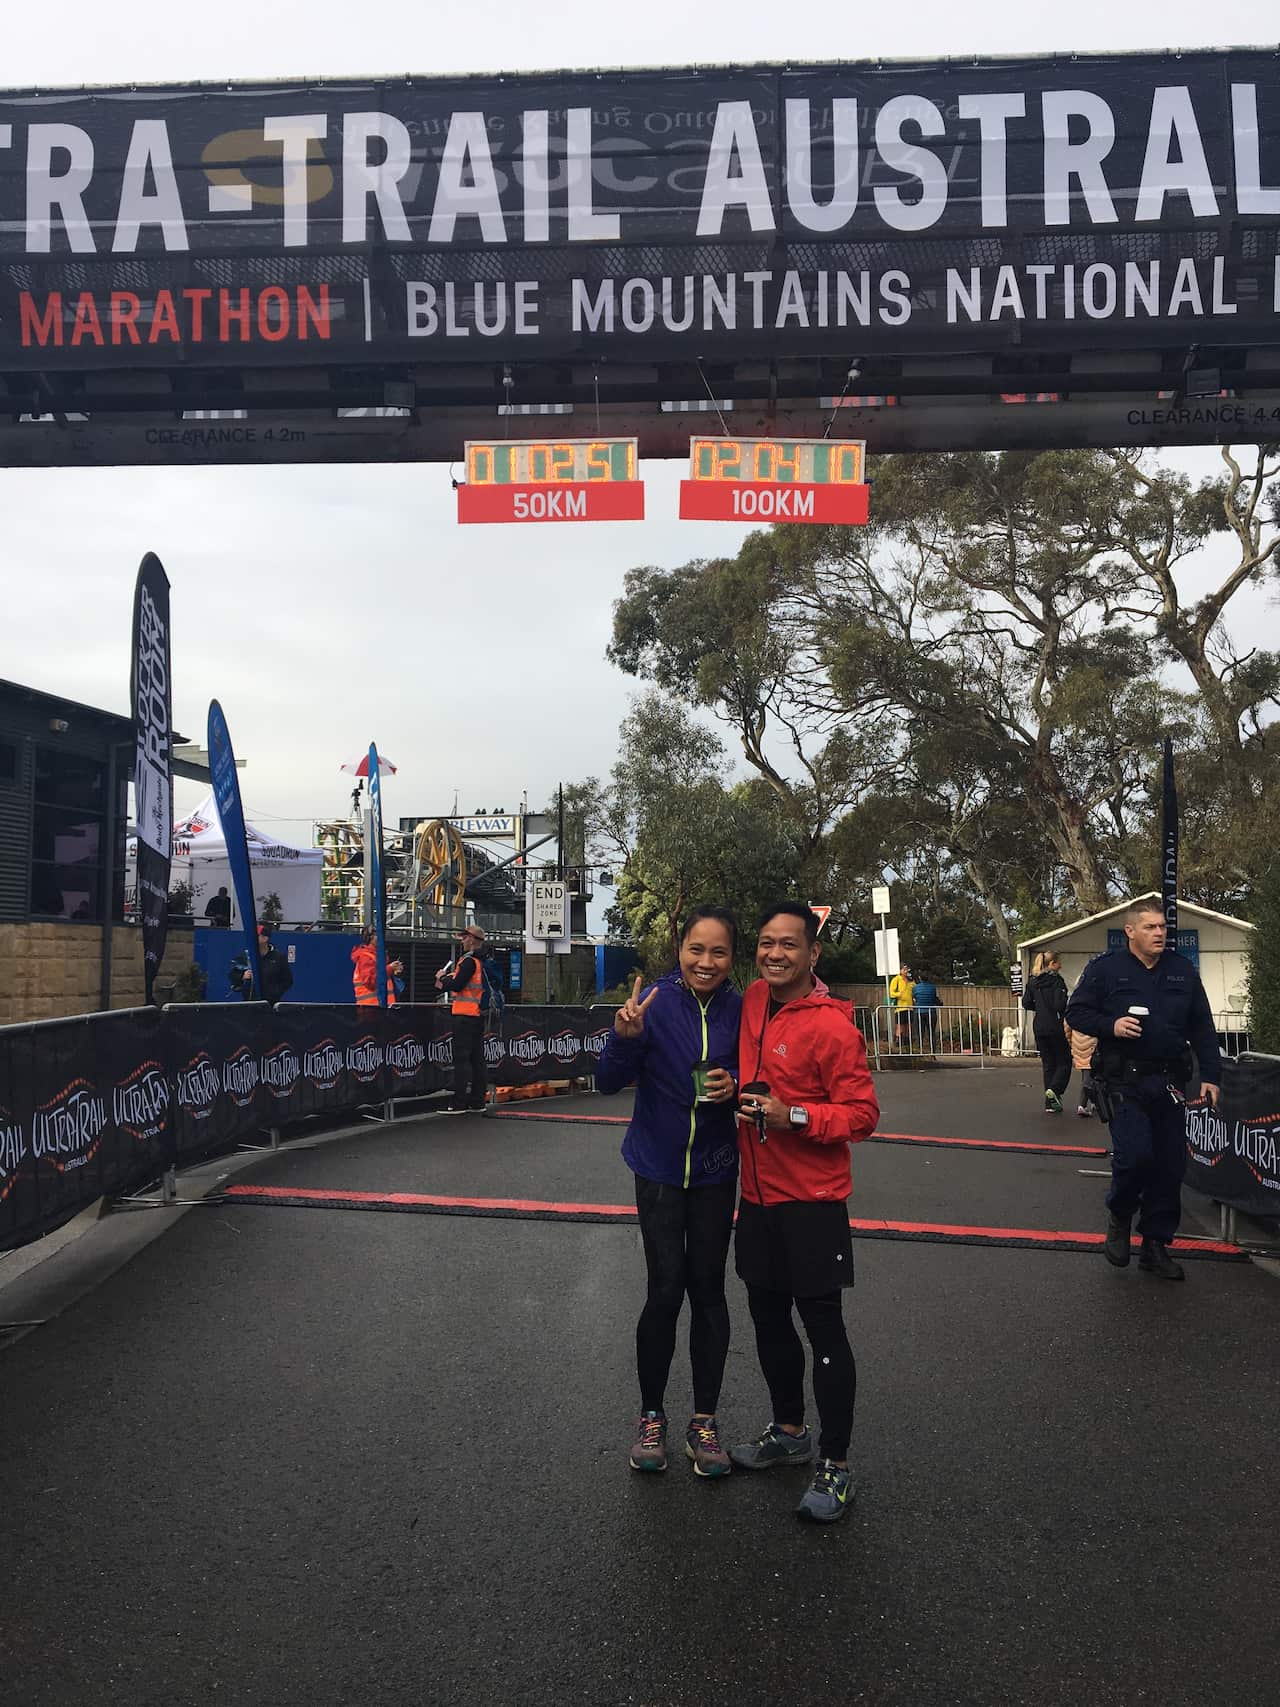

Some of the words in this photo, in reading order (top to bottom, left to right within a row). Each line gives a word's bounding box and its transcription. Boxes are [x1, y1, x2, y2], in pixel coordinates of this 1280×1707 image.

[0, 107, 621, 254] RA-TRAIL
[19, 283, 332, 347] MARATHON
[406, 281, 539, 337] BLUE
[571, 270, 912, 333] MOUNTAINS
[946, 255, 1238, 323] NATIONAL
[1127, 406, 1247, 425] CLEARANCE
[512, 490, 587, 519] 50KM
[732, 489, 815, 517] 100KM
[149, 597, 169, 778] ROOM
[536, 887, 563, 899] END
